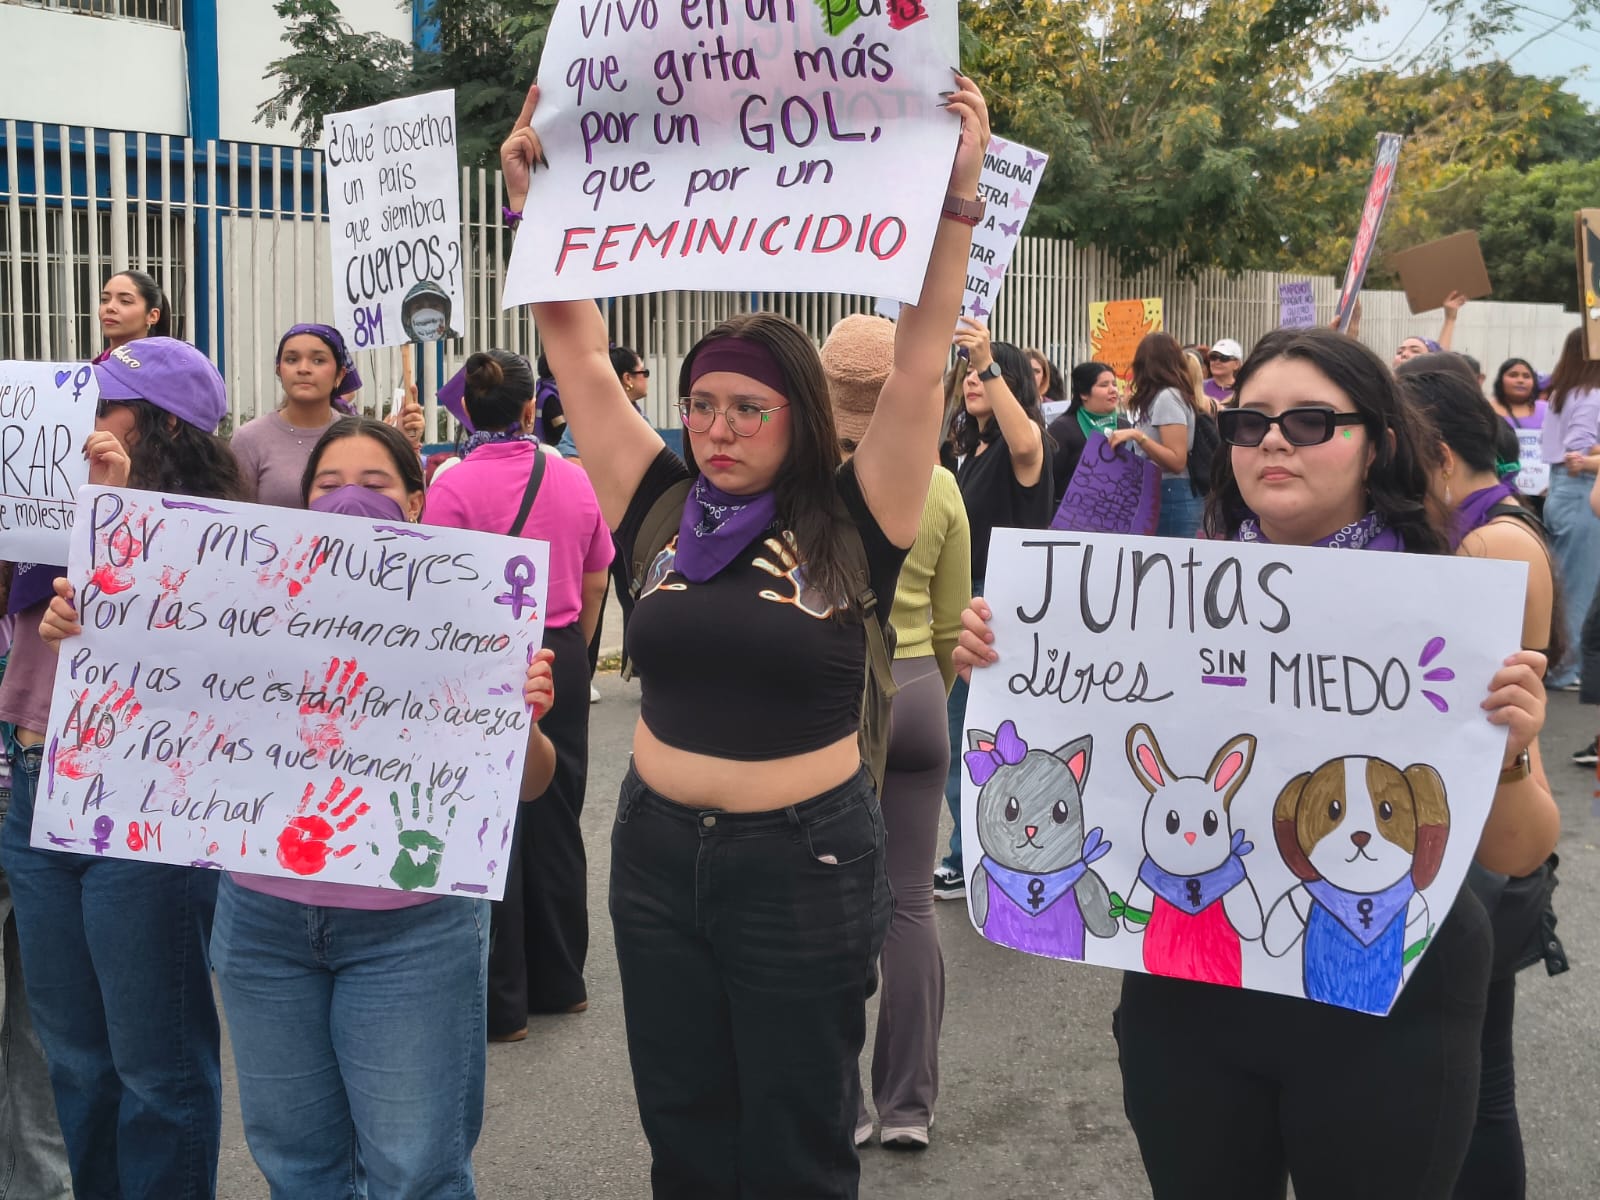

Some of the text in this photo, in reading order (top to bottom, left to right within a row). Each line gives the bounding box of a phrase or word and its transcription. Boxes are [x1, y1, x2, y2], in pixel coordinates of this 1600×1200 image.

[566, 33, 894, 107] que grita más
[580, 91, 882, 164] por un GOL,
[343, 178, 365, 205] un
[582, 159, 834, 211] que por un
[345, 194, 446, 250] que siembra
[555, 213, 908, 277] FEMINICIDIO
[353, 303, 385, 347] 8M
[0, 385, 36, 421] ero
[89, 493, 166, 571] Por
[80, 581, 141, 629] Por
[146, 594, 208, 631] las
[217, 605, 276, 638] que
[383, 624, 421, 648] en
[70, 647, 120, 685] Por
[129, 661, 181, 693] las
[201, 673, 256, 702] que
[360, 686, 402, 718] Por
[401, 690, 440, 722] las
[444, 704, 489, 726] que
[485, 703, 525, 736] ya
[1200, 648, 1247, 676] SIN
[1268, 651, 1411, 715] MIEDO
[141, 720, 194, 761] Por
[207, 737, 253, 764] las
[265, 743, 319, 770] que
[81, 773, 118, 815] A
[126, 820, 163, 853] 8M
